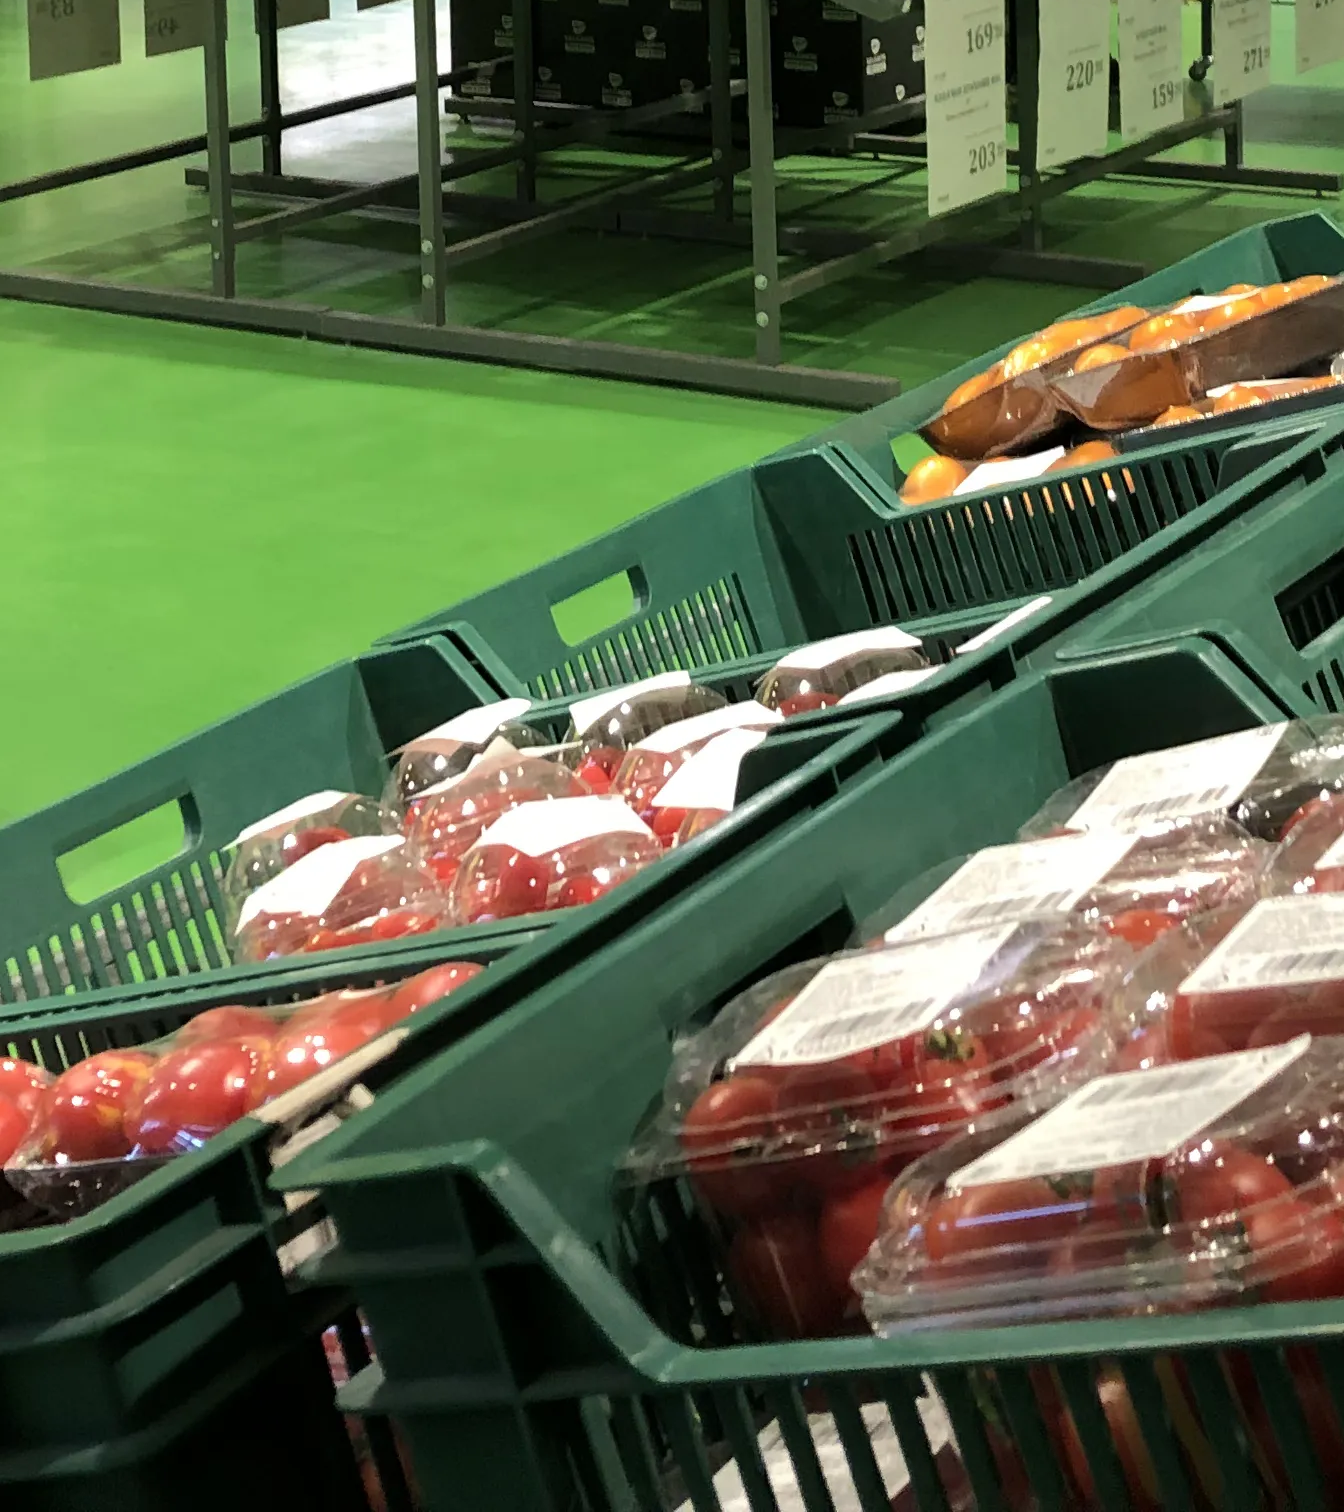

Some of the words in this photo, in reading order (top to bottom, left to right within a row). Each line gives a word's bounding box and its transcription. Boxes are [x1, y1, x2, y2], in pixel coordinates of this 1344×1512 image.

[967, 21, 994, 54] 169
[1066, 59, 1094, 92] 220
[1152, 80, 1175, 110] 159
[968, 141, 996, 175] 203
